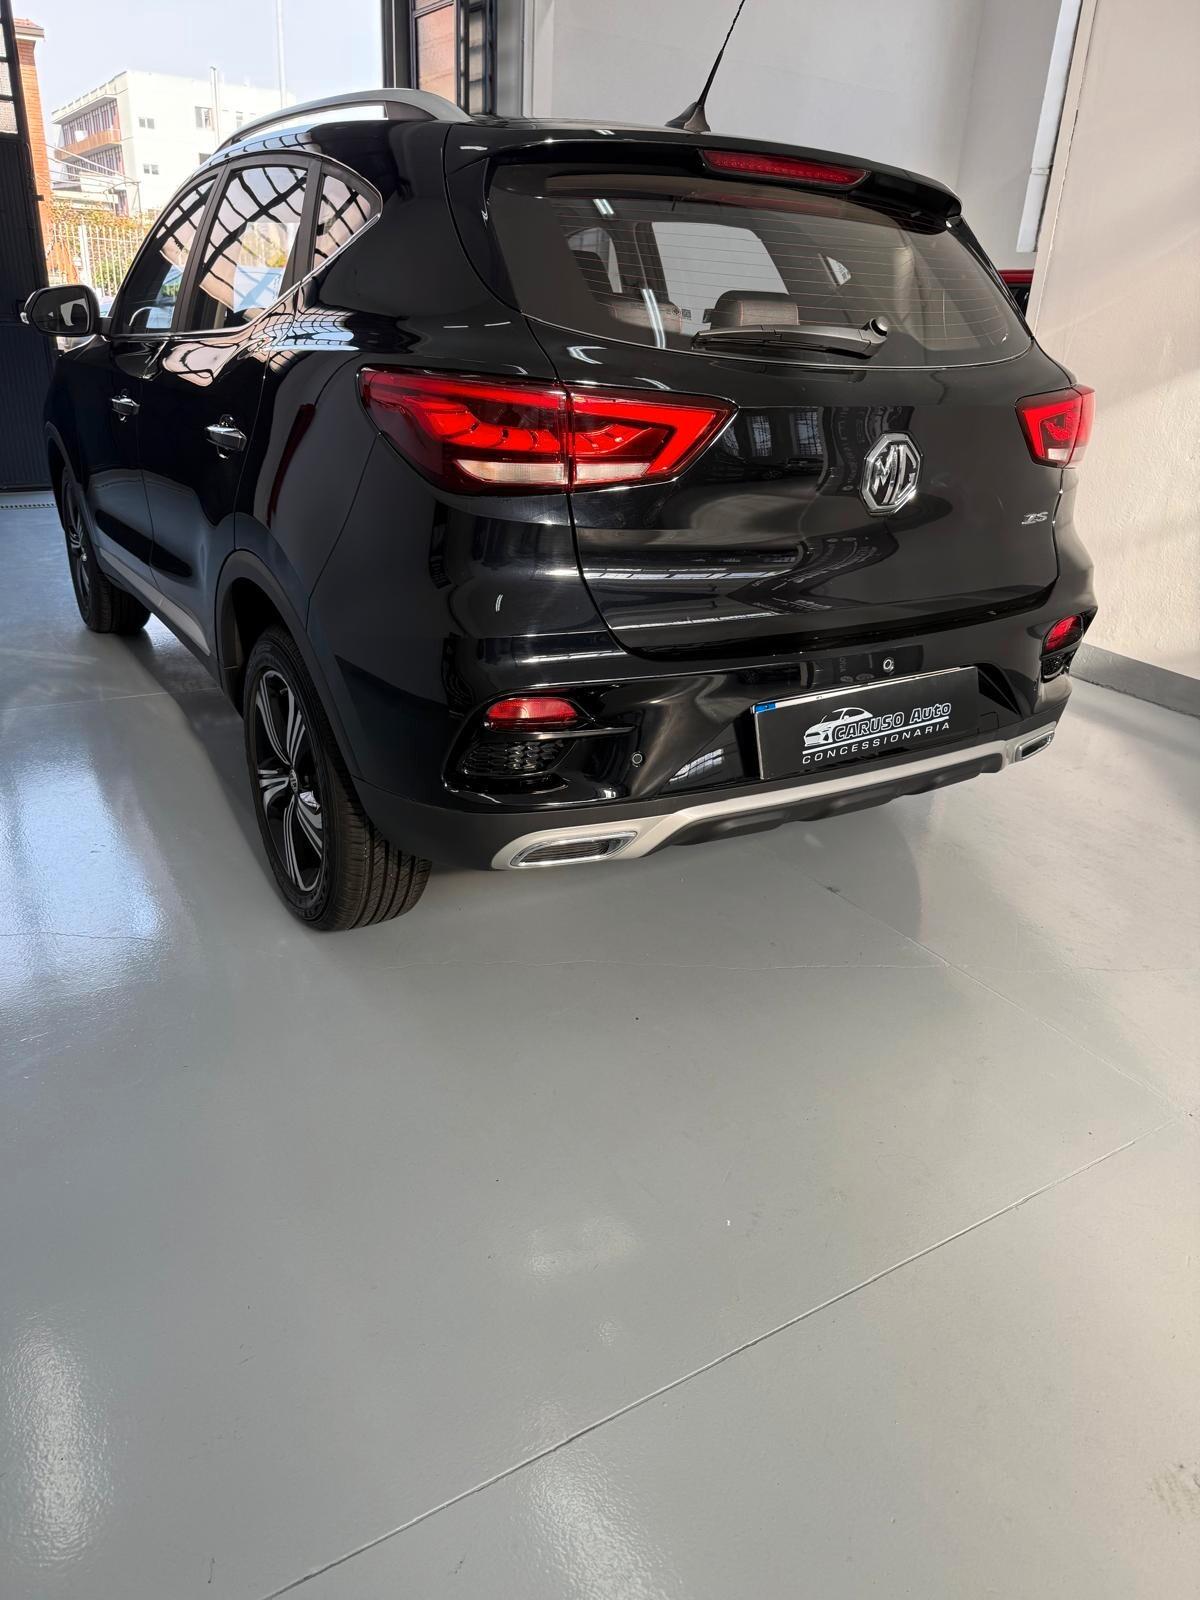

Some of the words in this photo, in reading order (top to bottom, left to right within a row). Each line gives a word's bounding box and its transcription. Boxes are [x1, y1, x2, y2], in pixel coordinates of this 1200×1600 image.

[871, 442, 918, 506] MG
[1021, 511, 1049, 525] ZS
[834, 712, 905, 742] CARUSO
[910, 702, 952, 723] Auto
[802, 723, 950, 765] CONCESSIONARIA
